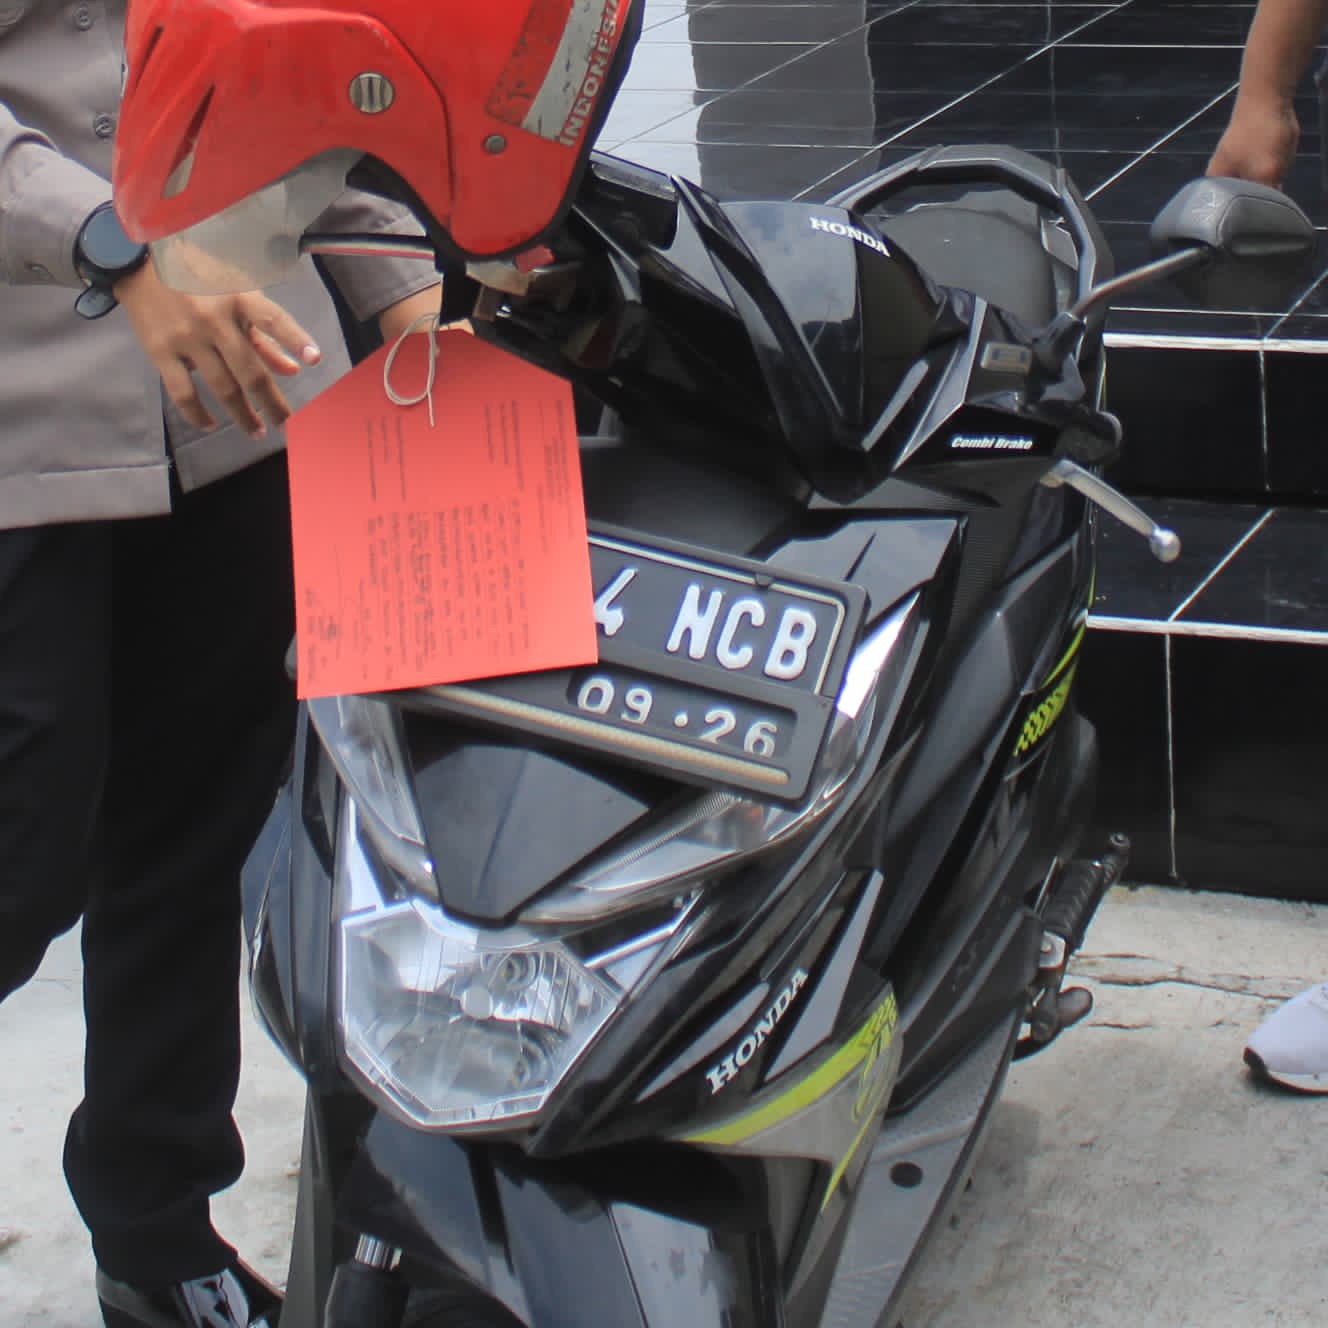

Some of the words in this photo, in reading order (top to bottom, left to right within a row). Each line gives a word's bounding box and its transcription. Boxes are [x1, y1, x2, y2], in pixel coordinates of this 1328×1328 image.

[809, 216, 891, 258] HONDA
[951, 436, 995, 449] Combi
[593, 567, 638, 637] 4
[666, 581, 817, 681] NCB
[704, 968, 809, 1096] HONDA
